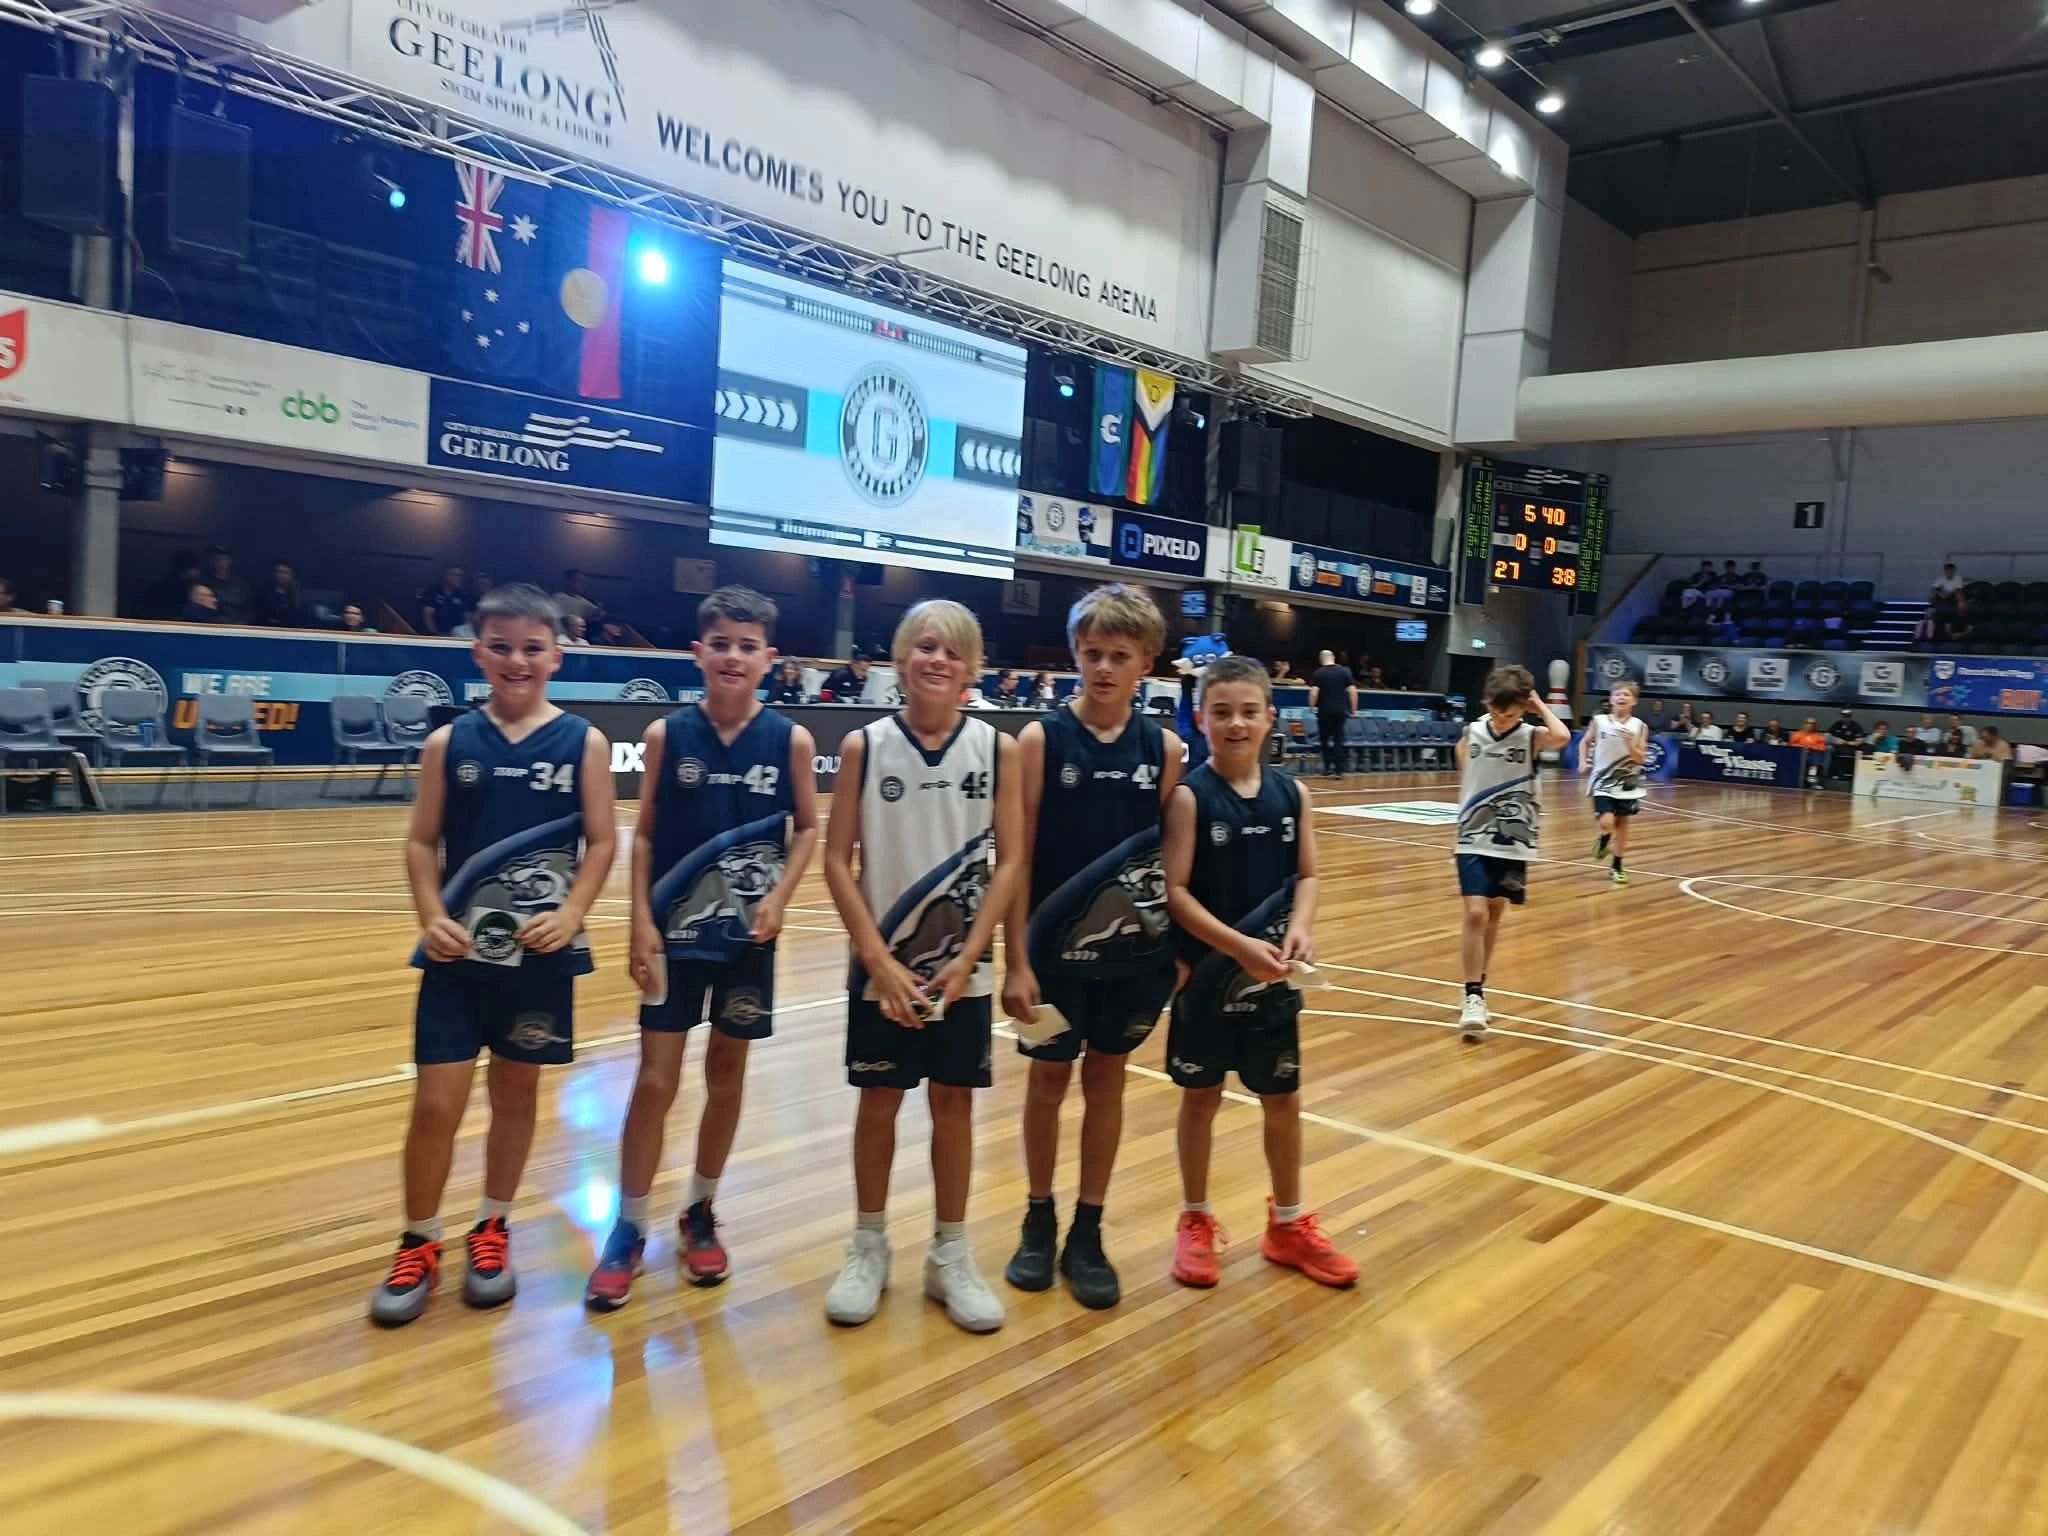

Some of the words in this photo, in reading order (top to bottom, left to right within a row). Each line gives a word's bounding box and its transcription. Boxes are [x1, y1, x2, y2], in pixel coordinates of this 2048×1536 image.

[389, 16, 612, 126] GEELONG
[656, 112, 824, 204] WELCOMES
[837, 180, 889, 226] YOU
[901, 205, 932, 241] TO
[942, 222, 988, 262] THE
[996, 242, 1091, 299] GEELONG
[1097, 281, 1159, 322] ARENA
[281, 389, 340, 424] cbb
[440, 433, 570, 471] GEELONG
[1524, 504, 1536, 523] 5
[1541, 506, 1566, 526] 40
[1143, 532, 1200, 561] PIXELD
[1494, 560, 1520, 580] 27
[1552, 567, 1576, 586] 38
[182, 672, 224, 694] WE
[227, 674, 272, 696] ARE
[529, 761, 575, 792] 34
[743, 764, 779, 795] 42
